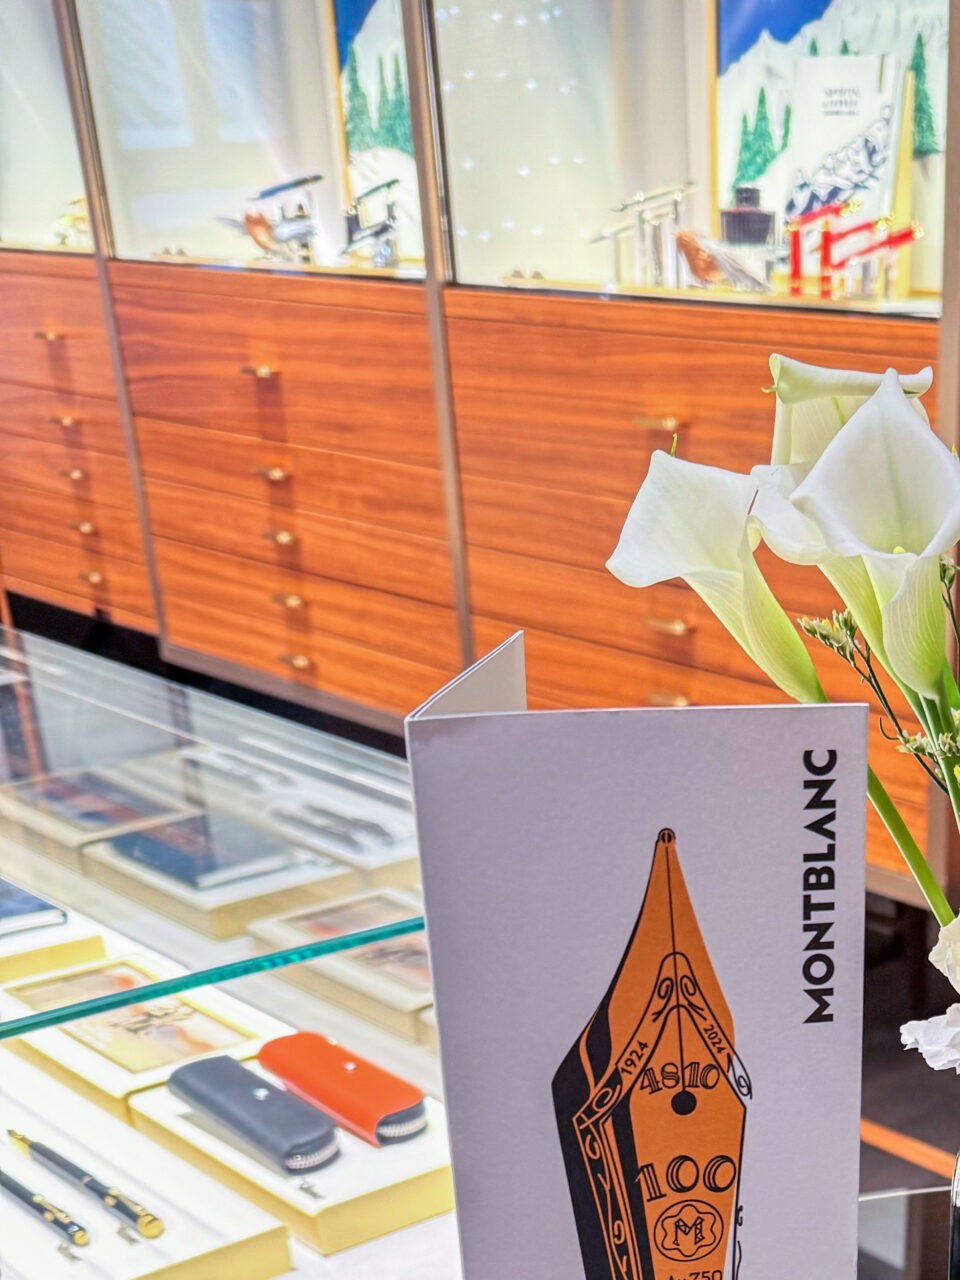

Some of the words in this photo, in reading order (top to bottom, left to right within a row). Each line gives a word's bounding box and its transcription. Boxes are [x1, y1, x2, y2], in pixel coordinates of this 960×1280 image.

[802, 749, 838, 1024] MONTBLANC
[703, 1024, 727, 1055] 2024
[620, 1040, 649, 1076] 1924
[639, 1061, 720, 1095] 4810
[634, 1155, 737, 1202] 100
